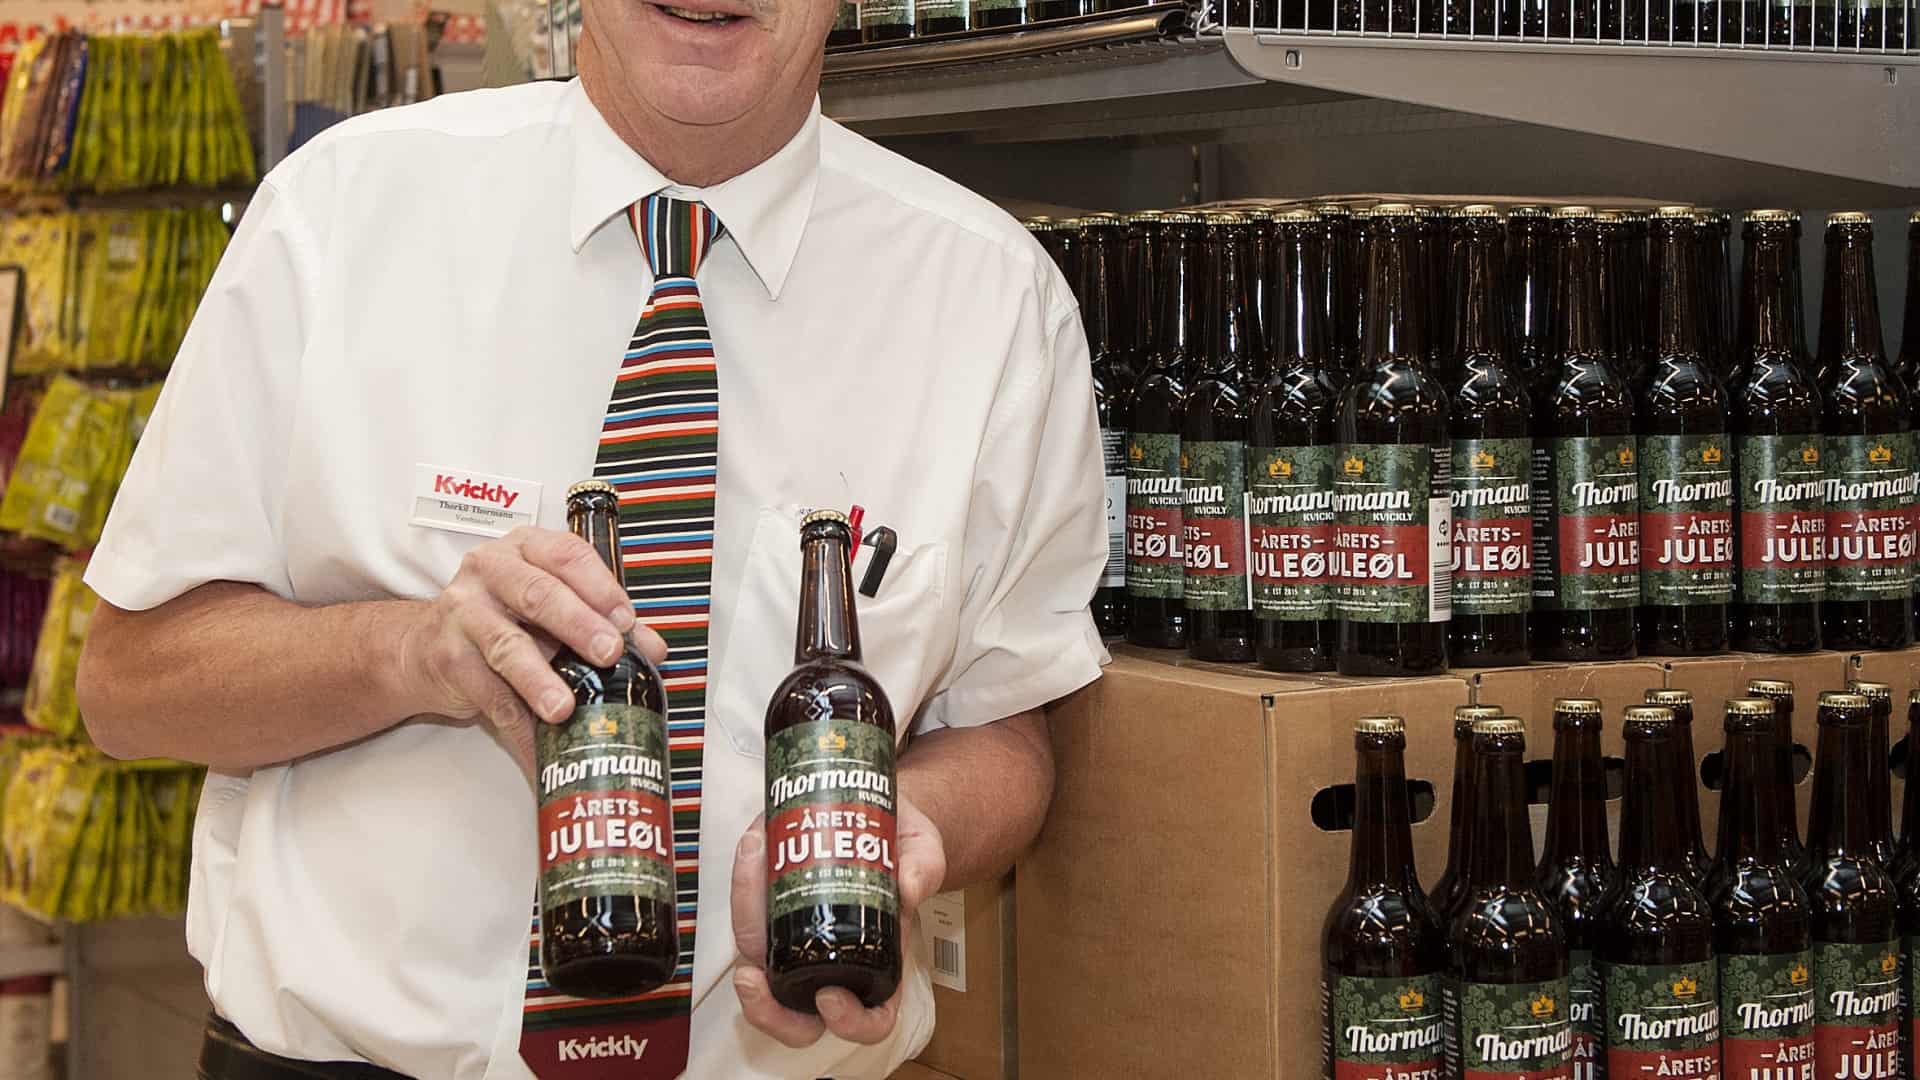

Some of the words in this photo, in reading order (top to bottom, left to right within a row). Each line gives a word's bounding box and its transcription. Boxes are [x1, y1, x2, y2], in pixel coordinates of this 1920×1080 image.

[434, 474, 519, 508] Kvickly
[1373, 511, 1414, 522] KVICKLY
[541, 755, 663, 795] Thormann
[770, 769, 890, 807] Thormann
[547, 818, 668, 862] JULEØL
[774, 830, 894, 872] JULEØL
[558, 1034, 649, 1061] Kvickly
